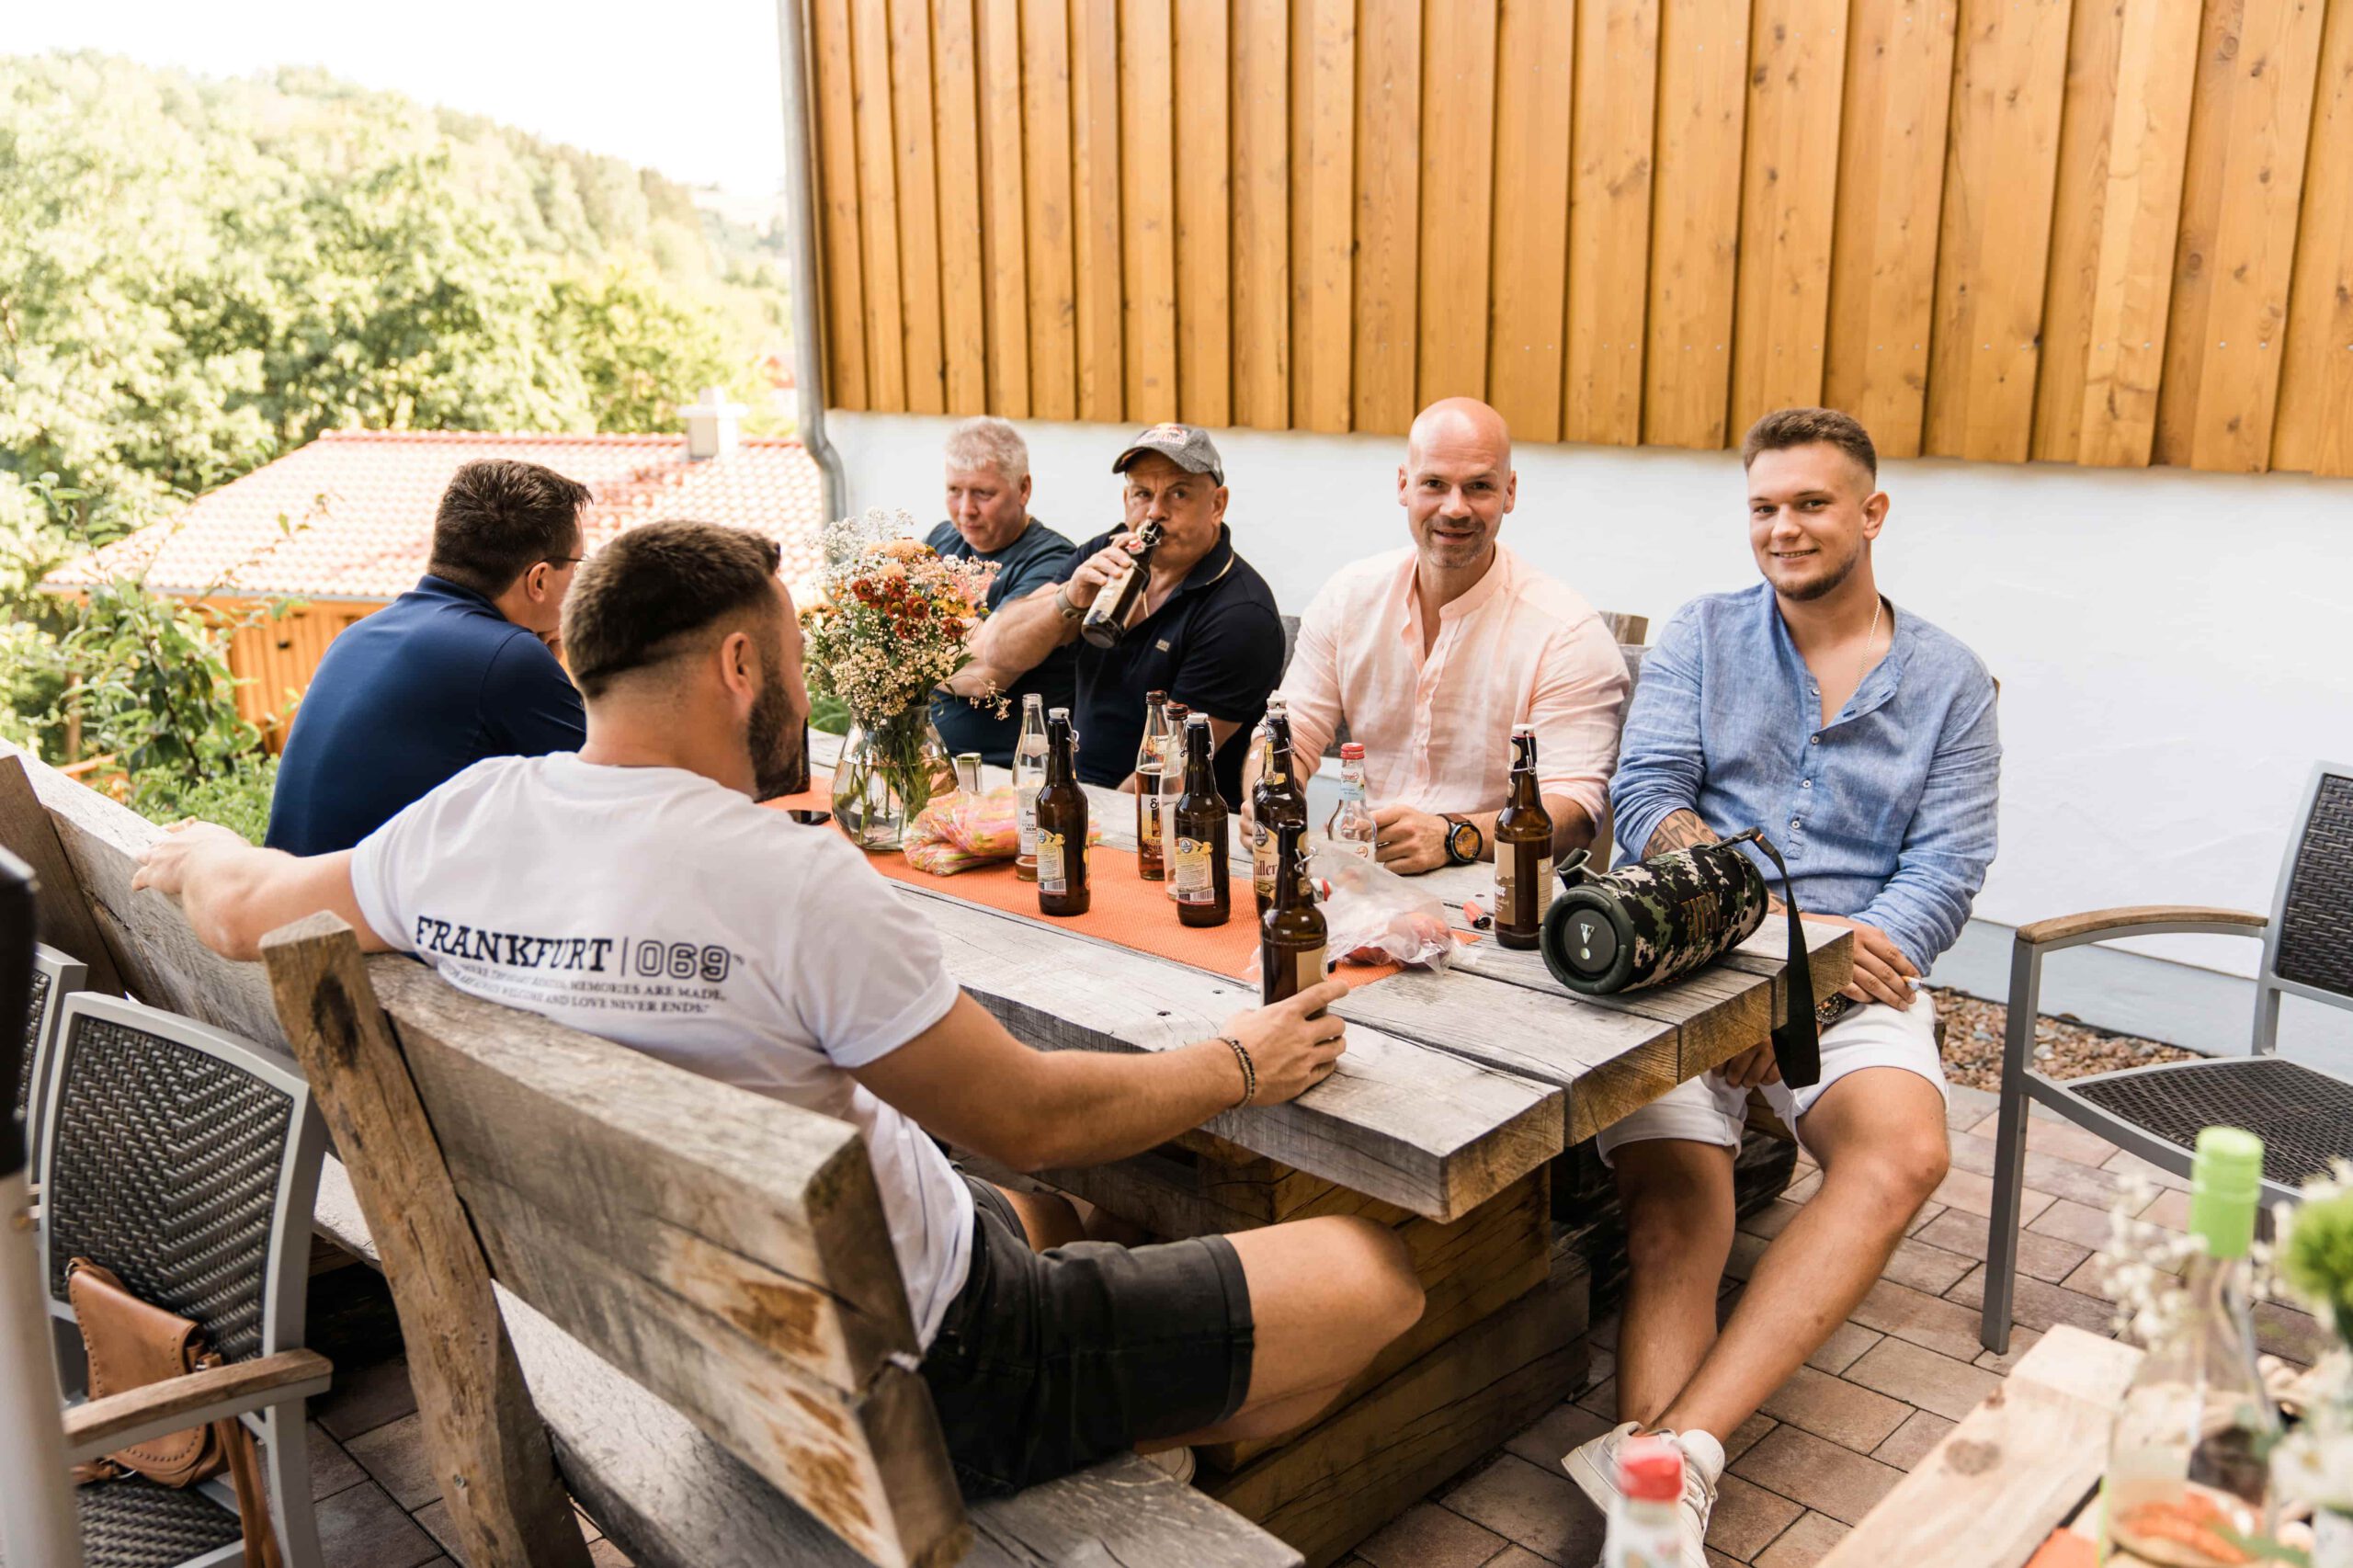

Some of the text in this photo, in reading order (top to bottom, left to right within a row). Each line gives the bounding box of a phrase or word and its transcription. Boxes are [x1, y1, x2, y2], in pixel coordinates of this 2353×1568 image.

[415, 915, 612, 971] FRANKFURT
[635, 939, 731, 983] 069
[570, 981, 641, 995] MEMORIES
[645, 984, 673, 996] ARE
[571, 996, 607, 1009] LOVE
[609, 998, 657, 1013] NEVER
